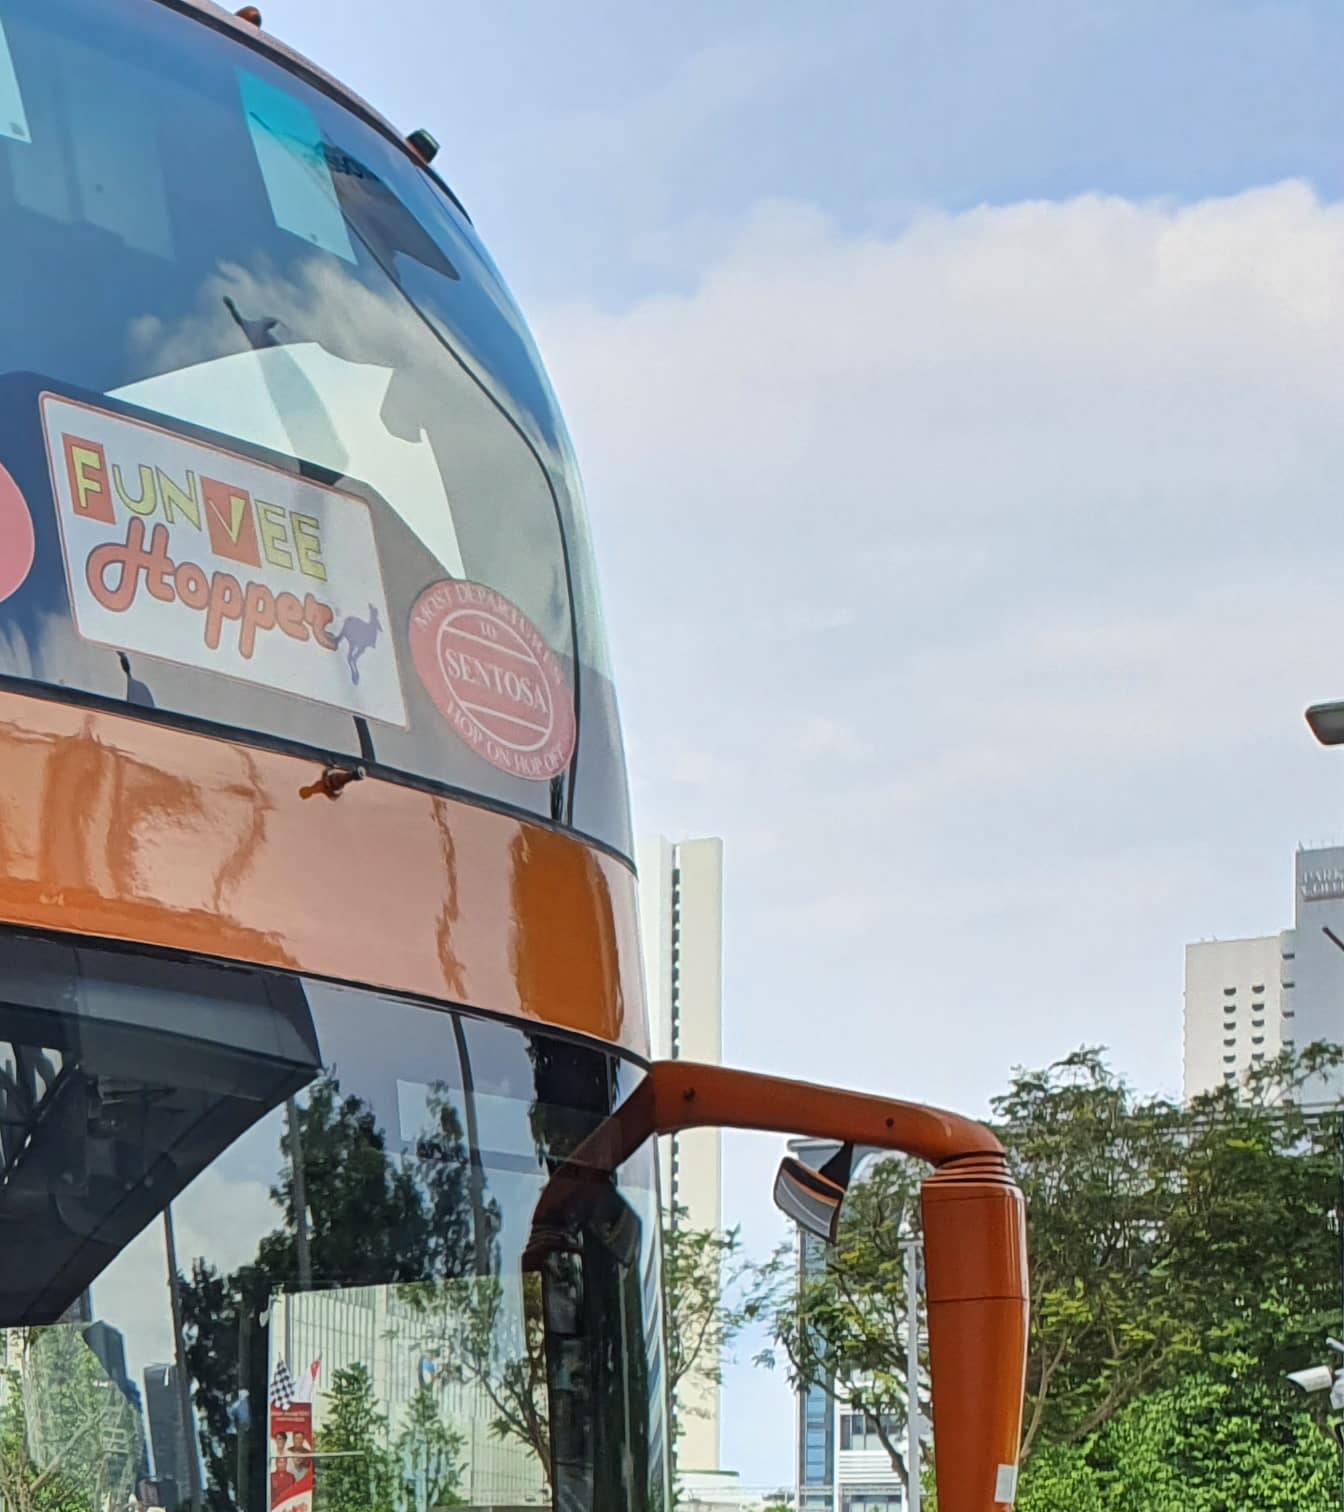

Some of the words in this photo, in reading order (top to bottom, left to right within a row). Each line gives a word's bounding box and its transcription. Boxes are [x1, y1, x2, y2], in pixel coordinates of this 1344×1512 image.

[69, 445, 327, 582] FUNVEE
[86, 517, 338, 660] Hopper
[445, 649, 549, 713] SENTOSA
[487, 741, 512, 768] ON
